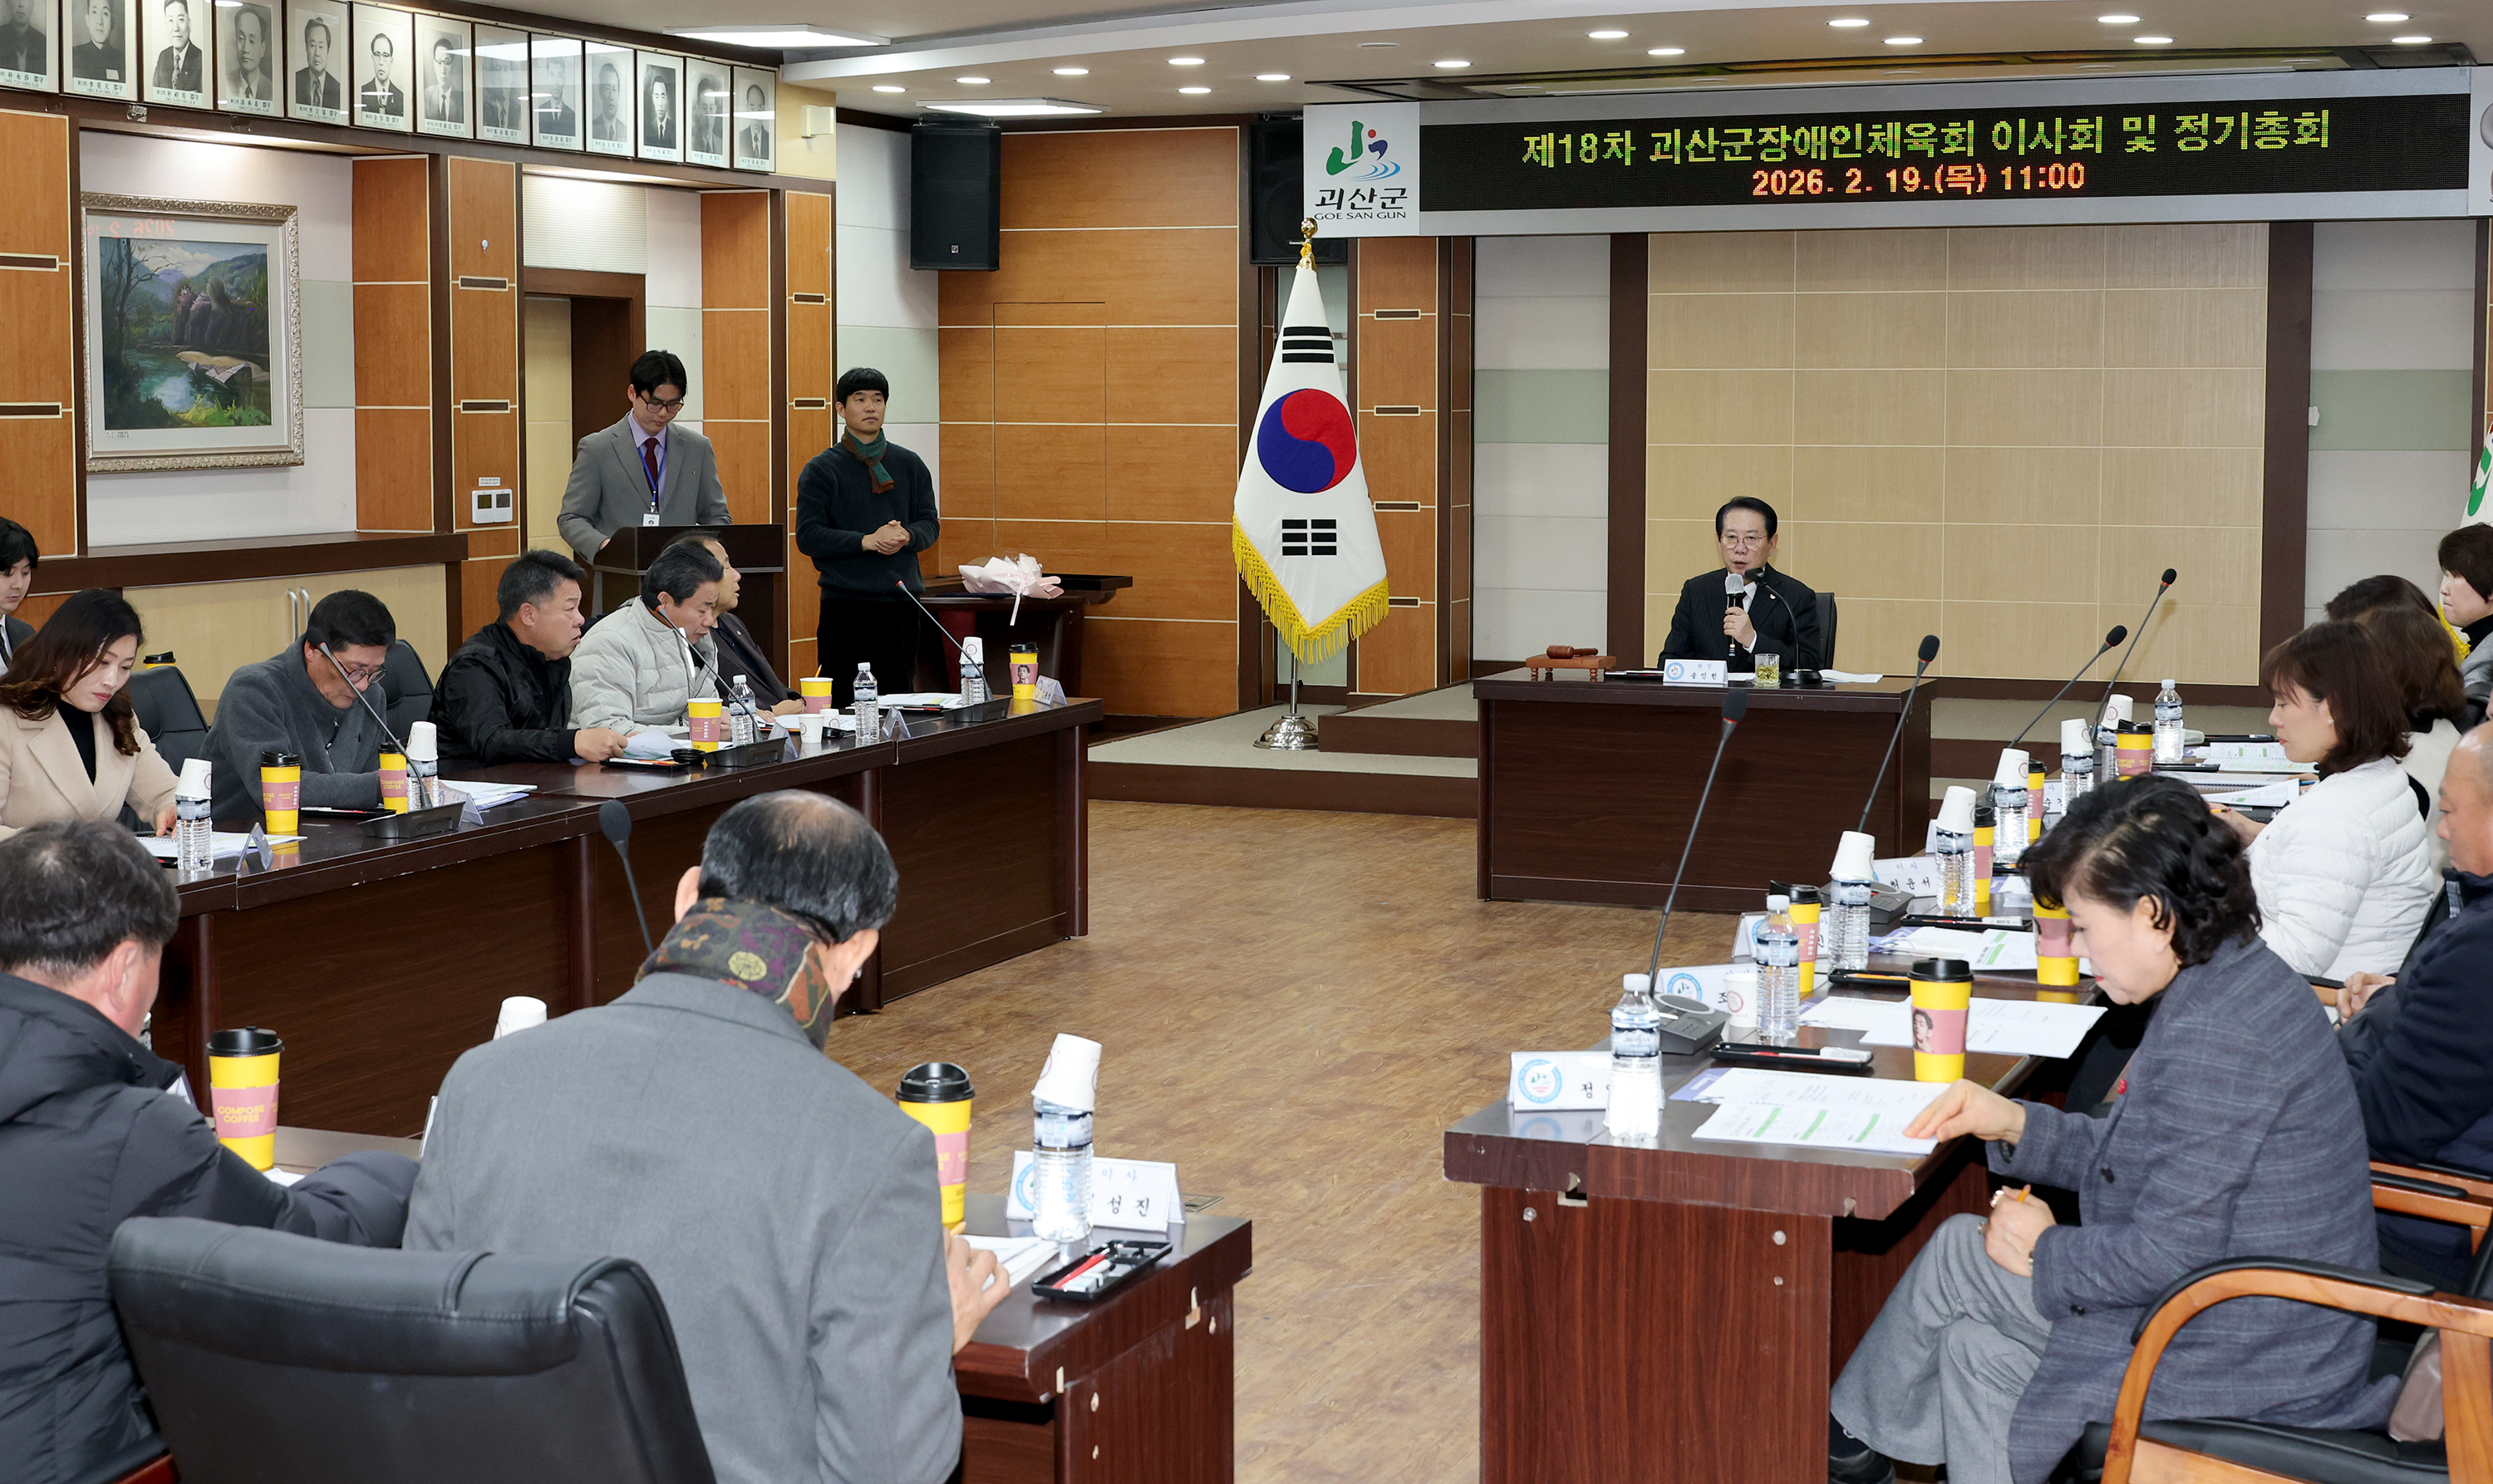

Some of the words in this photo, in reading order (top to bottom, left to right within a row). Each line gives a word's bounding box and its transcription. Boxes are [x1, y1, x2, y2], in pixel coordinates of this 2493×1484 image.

[1522, 130, 1636, 168] 제18차
[1650, 120, 1974, 165] 괴산군장애인체육회
[1992, 116, 2102, 155] 이사회
[2122, 114, 2156, 153] 및
[2174, 110, 2329, 151] 정기총회
[1753, 169, 1834, 196] 2026.
[1845, 167, 1873, 194] 2.
[1886, 163, 1987, 195] 19.(목)
[2000, 162, 2085, 190] 11:00
[1315, 187, 1408, 210] 괴산군
[1314, 212, 1343, 220] GOE
[1346, 212, 1374, 220] SAN
[1376, 211, 1406, 219] GUN
[1896, 861, 1918, 872] 이사
[217, 1104, 265, 1115] COMPOSE
[224, 1113, 260, 1123] COFFEE
[1102, 1167, 1138, 1182] 이사
[1092, 1194, 1149, 1217] 성진
